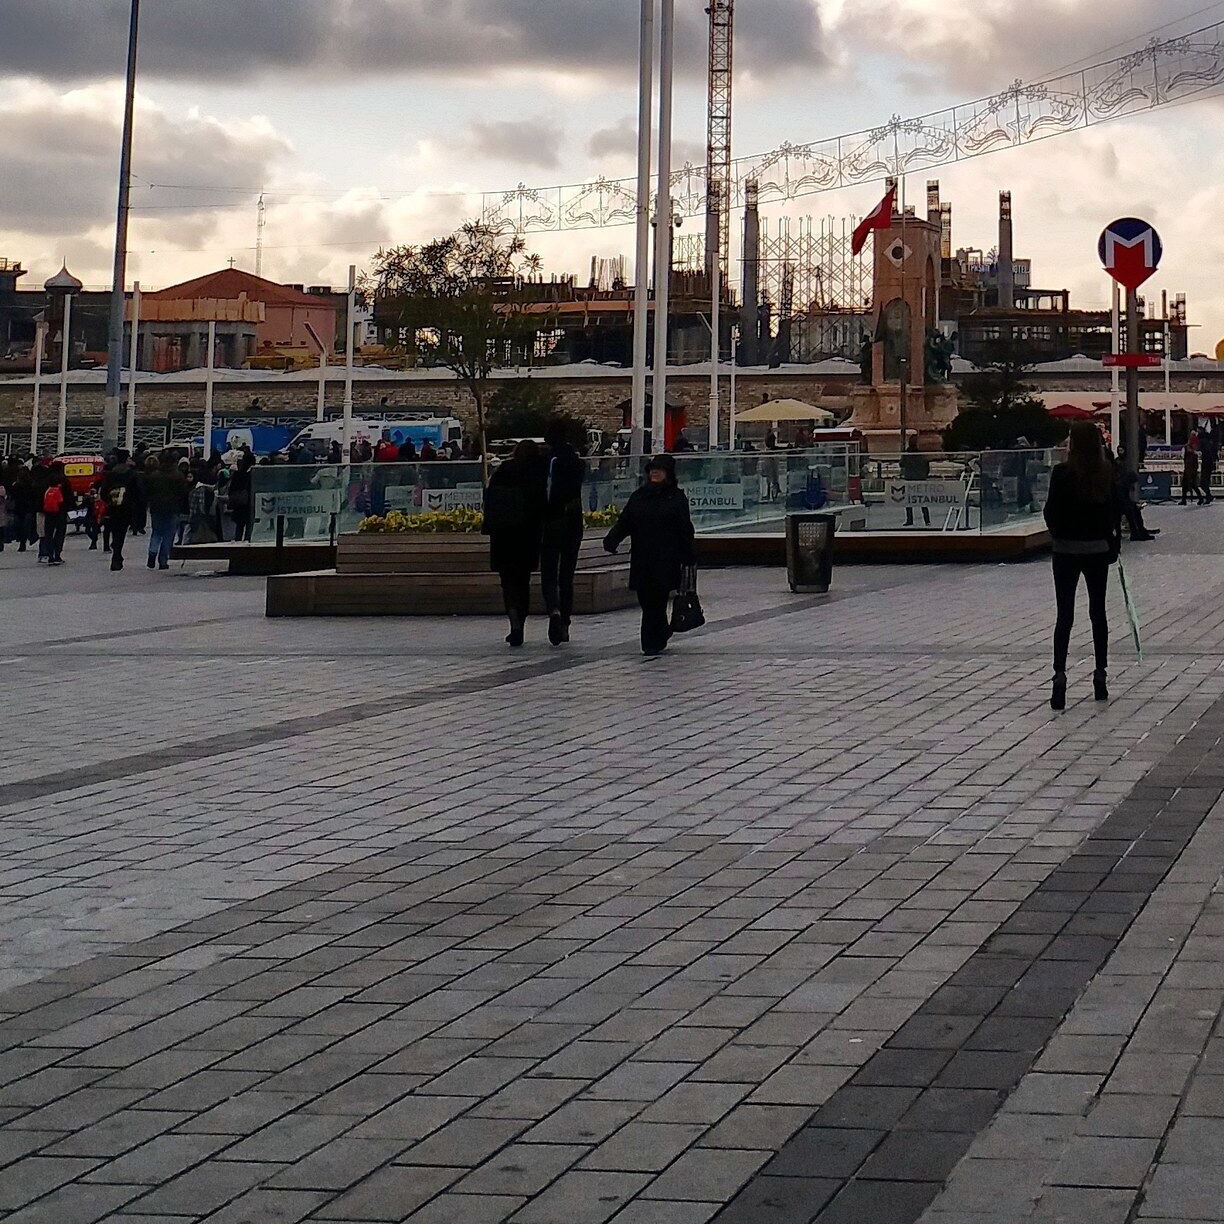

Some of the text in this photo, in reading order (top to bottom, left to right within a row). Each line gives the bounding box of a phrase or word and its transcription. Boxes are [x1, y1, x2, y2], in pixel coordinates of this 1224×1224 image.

[687, 486, 723, 495] METRO
[908, 484, 946, 493] METRO
[276, 495, 313, 505] METRO
[690, 497, 737, 506] STANBUL
